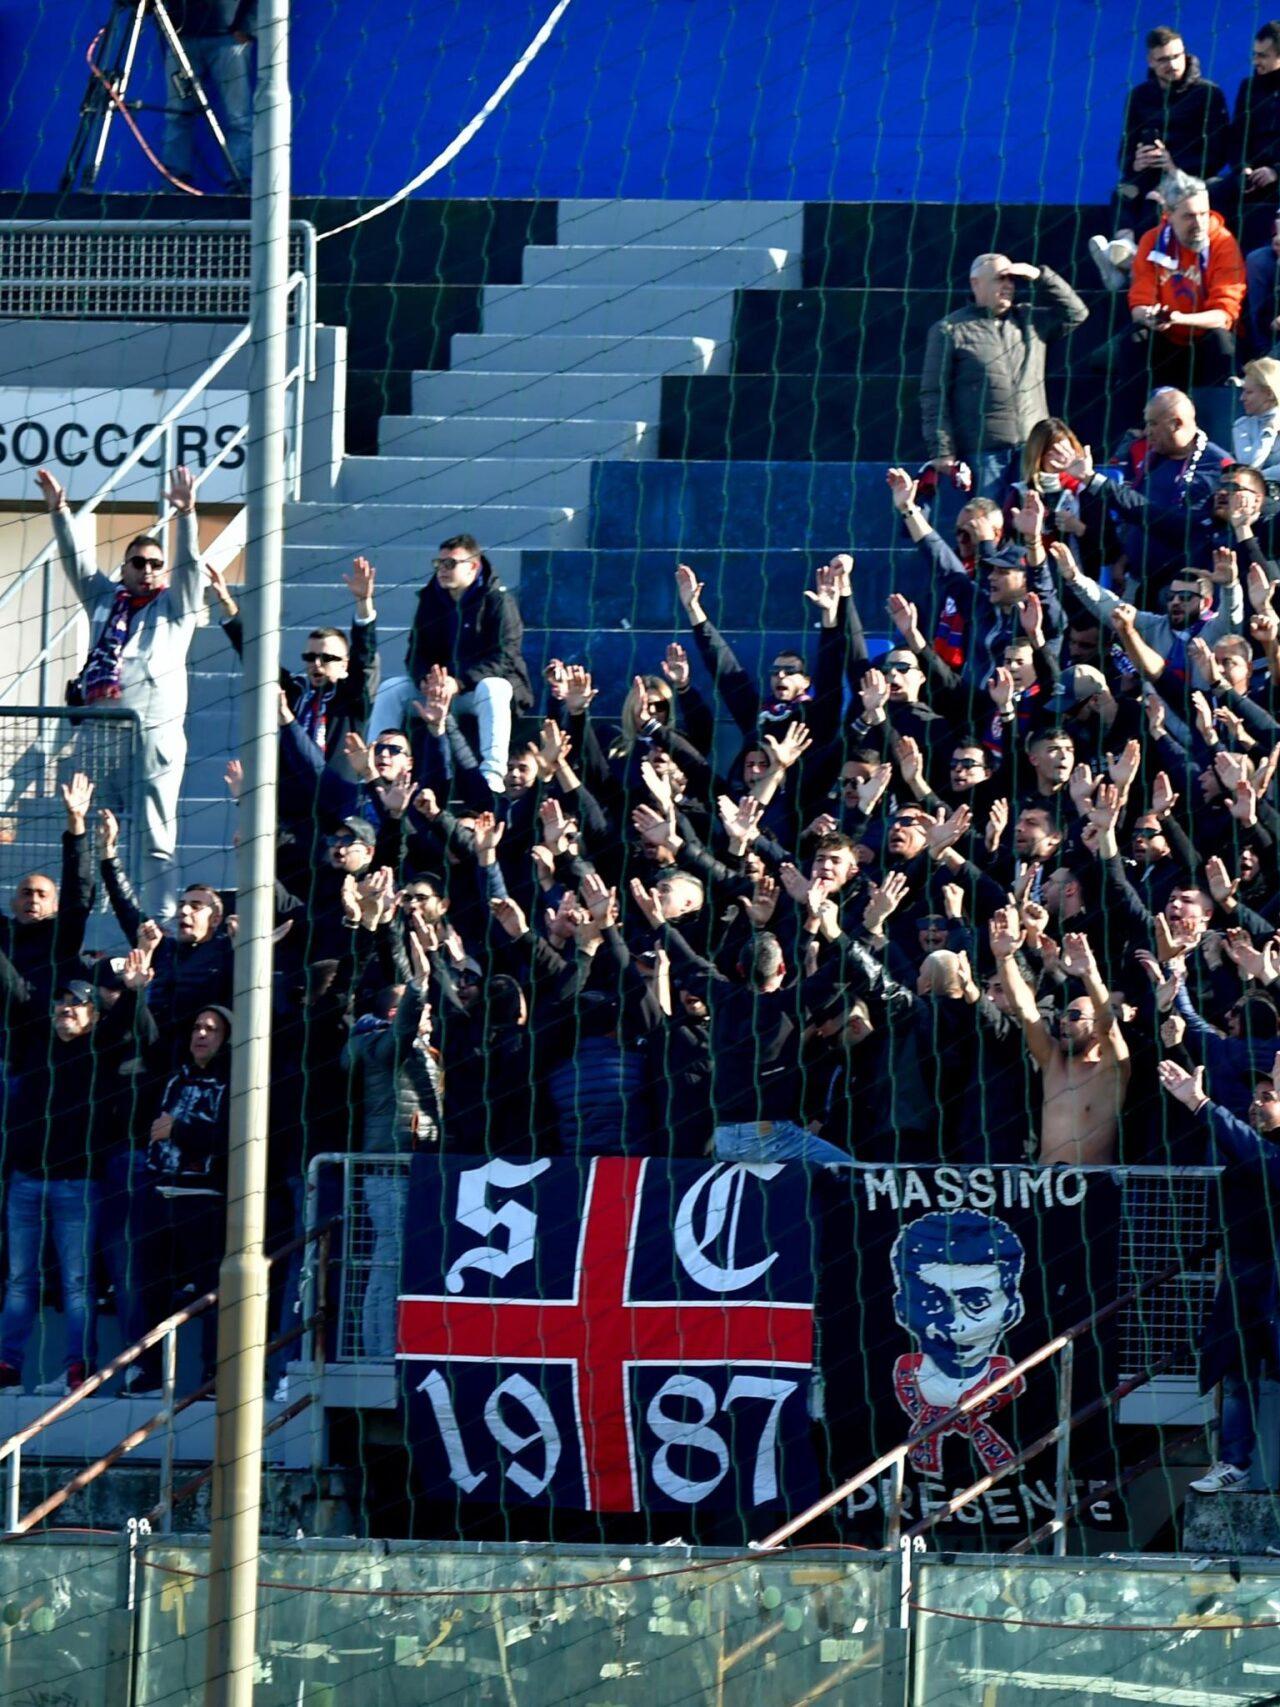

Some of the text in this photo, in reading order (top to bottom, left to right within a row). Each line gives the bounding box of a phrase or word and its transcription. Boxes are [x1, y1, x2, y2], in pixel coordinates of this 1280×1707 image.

[0, 421, 288, 470] OCCORS
[863, 1167, 1088, 1211] MASSIMO
[445, 1156, 788, 1294] S C
